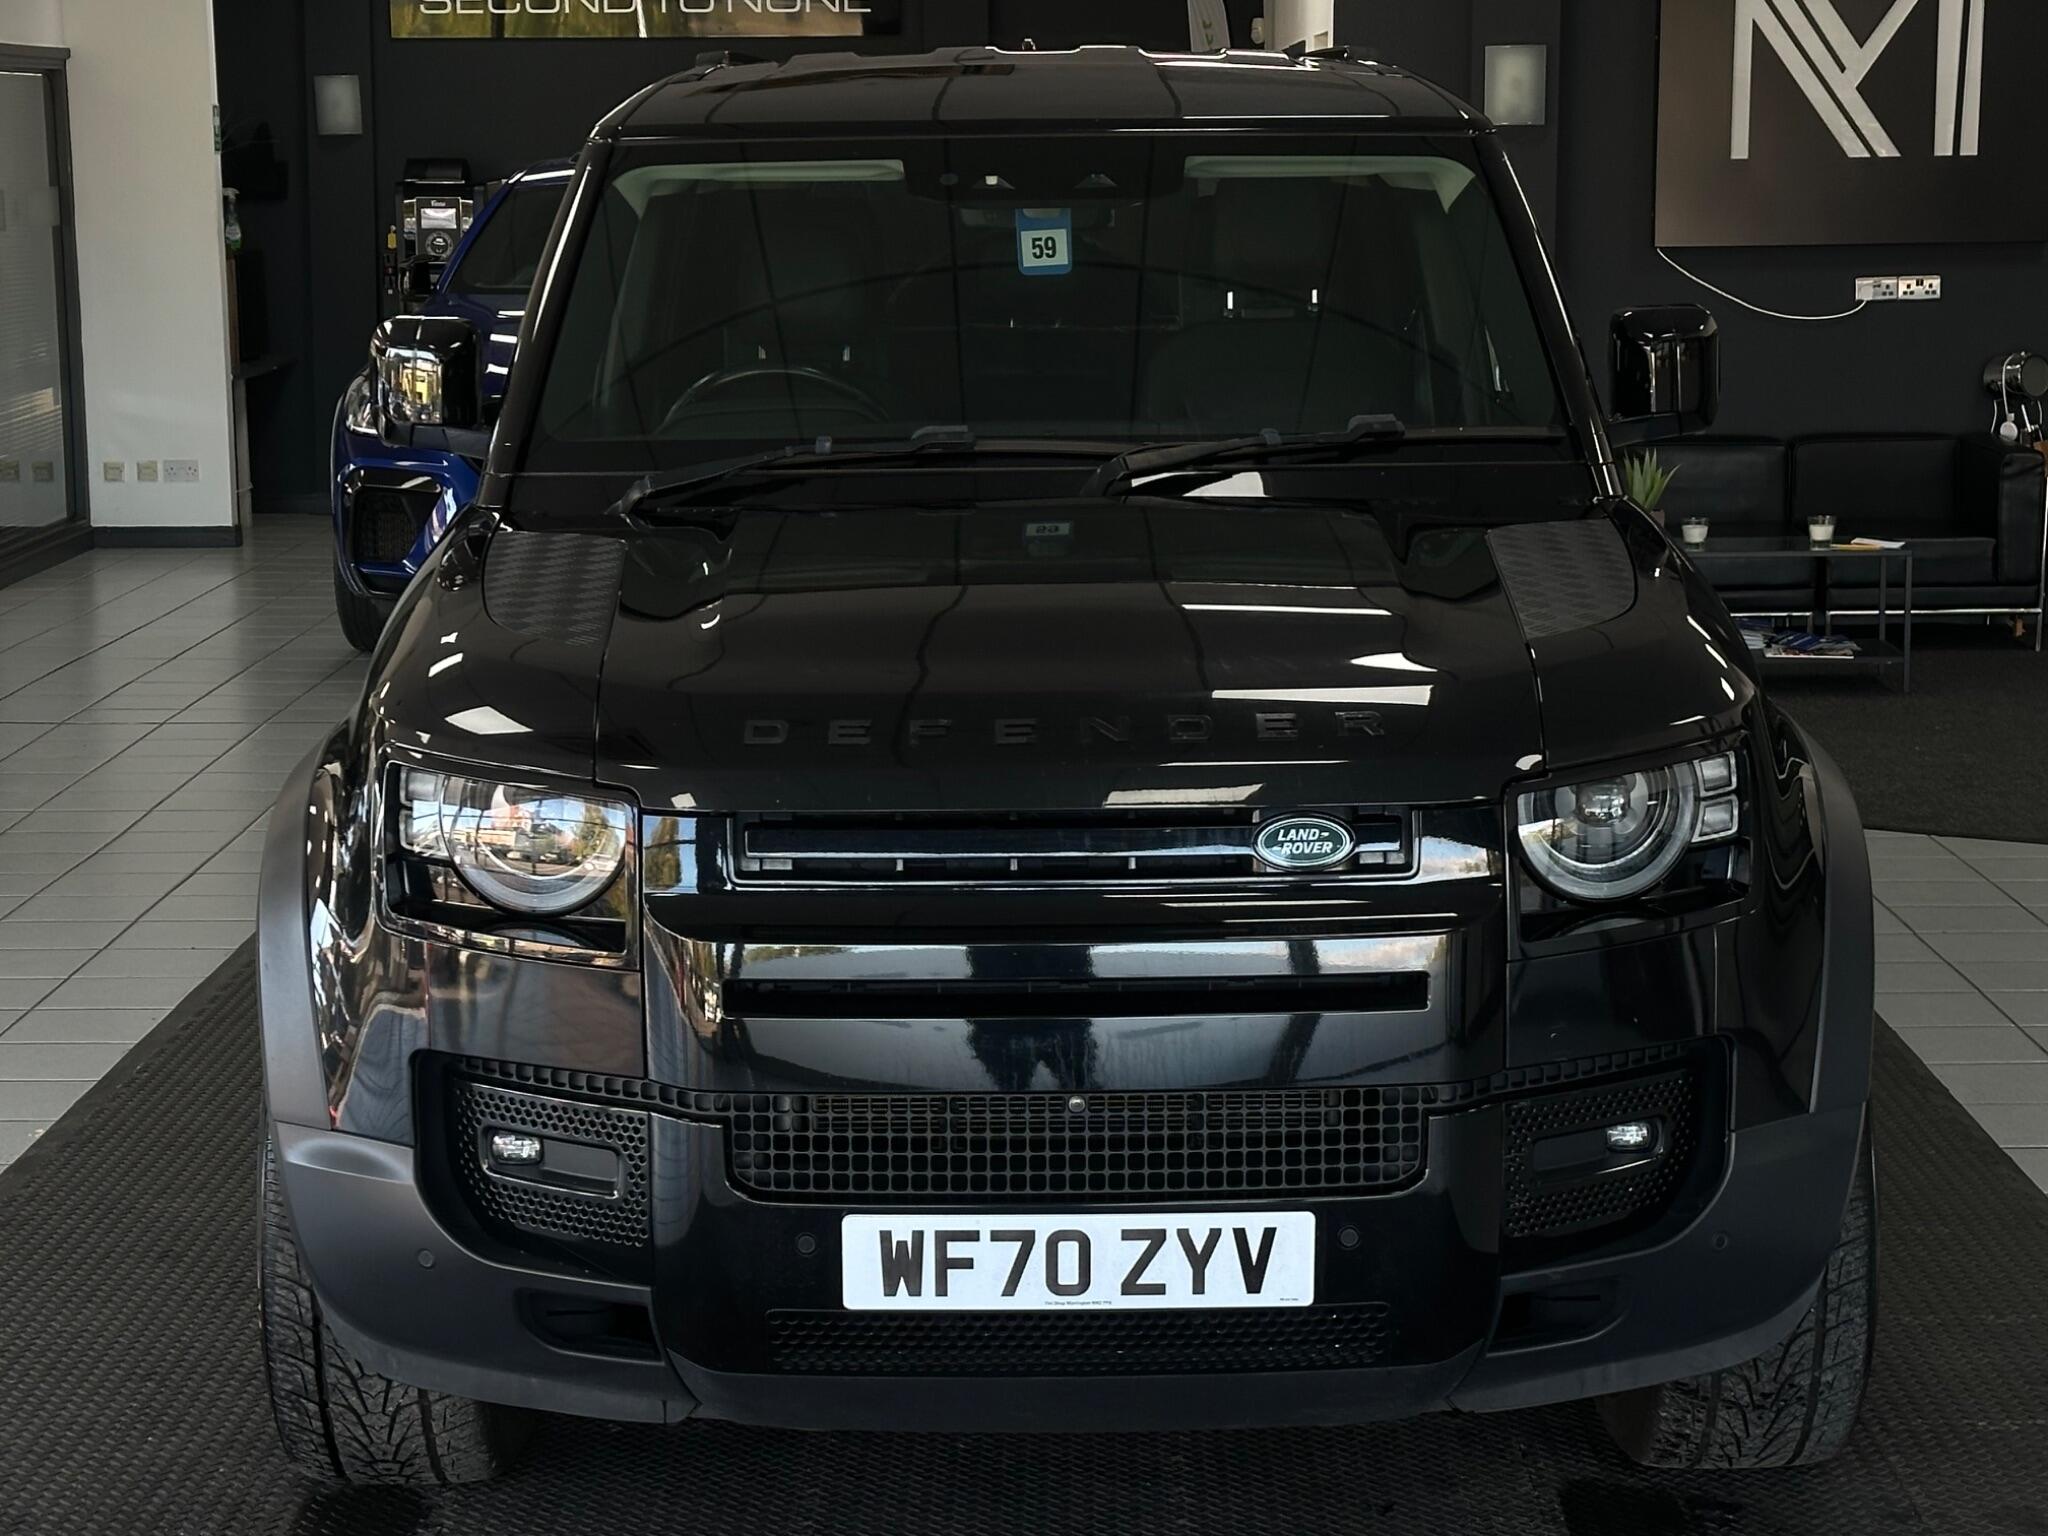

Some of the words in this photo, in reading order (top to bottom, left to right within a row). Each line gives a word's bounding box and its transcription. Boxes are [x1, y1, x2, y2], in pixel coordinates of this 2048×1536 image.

[1031, 236, 1057, 260] 59
[743, 711, 1385, 746] DEFENDER
[1280, 841, 1333, 855] ROVER
[879, 1229, 1091, 1297] WF70
[1120, 1227, 1277, 1296] ZYV
